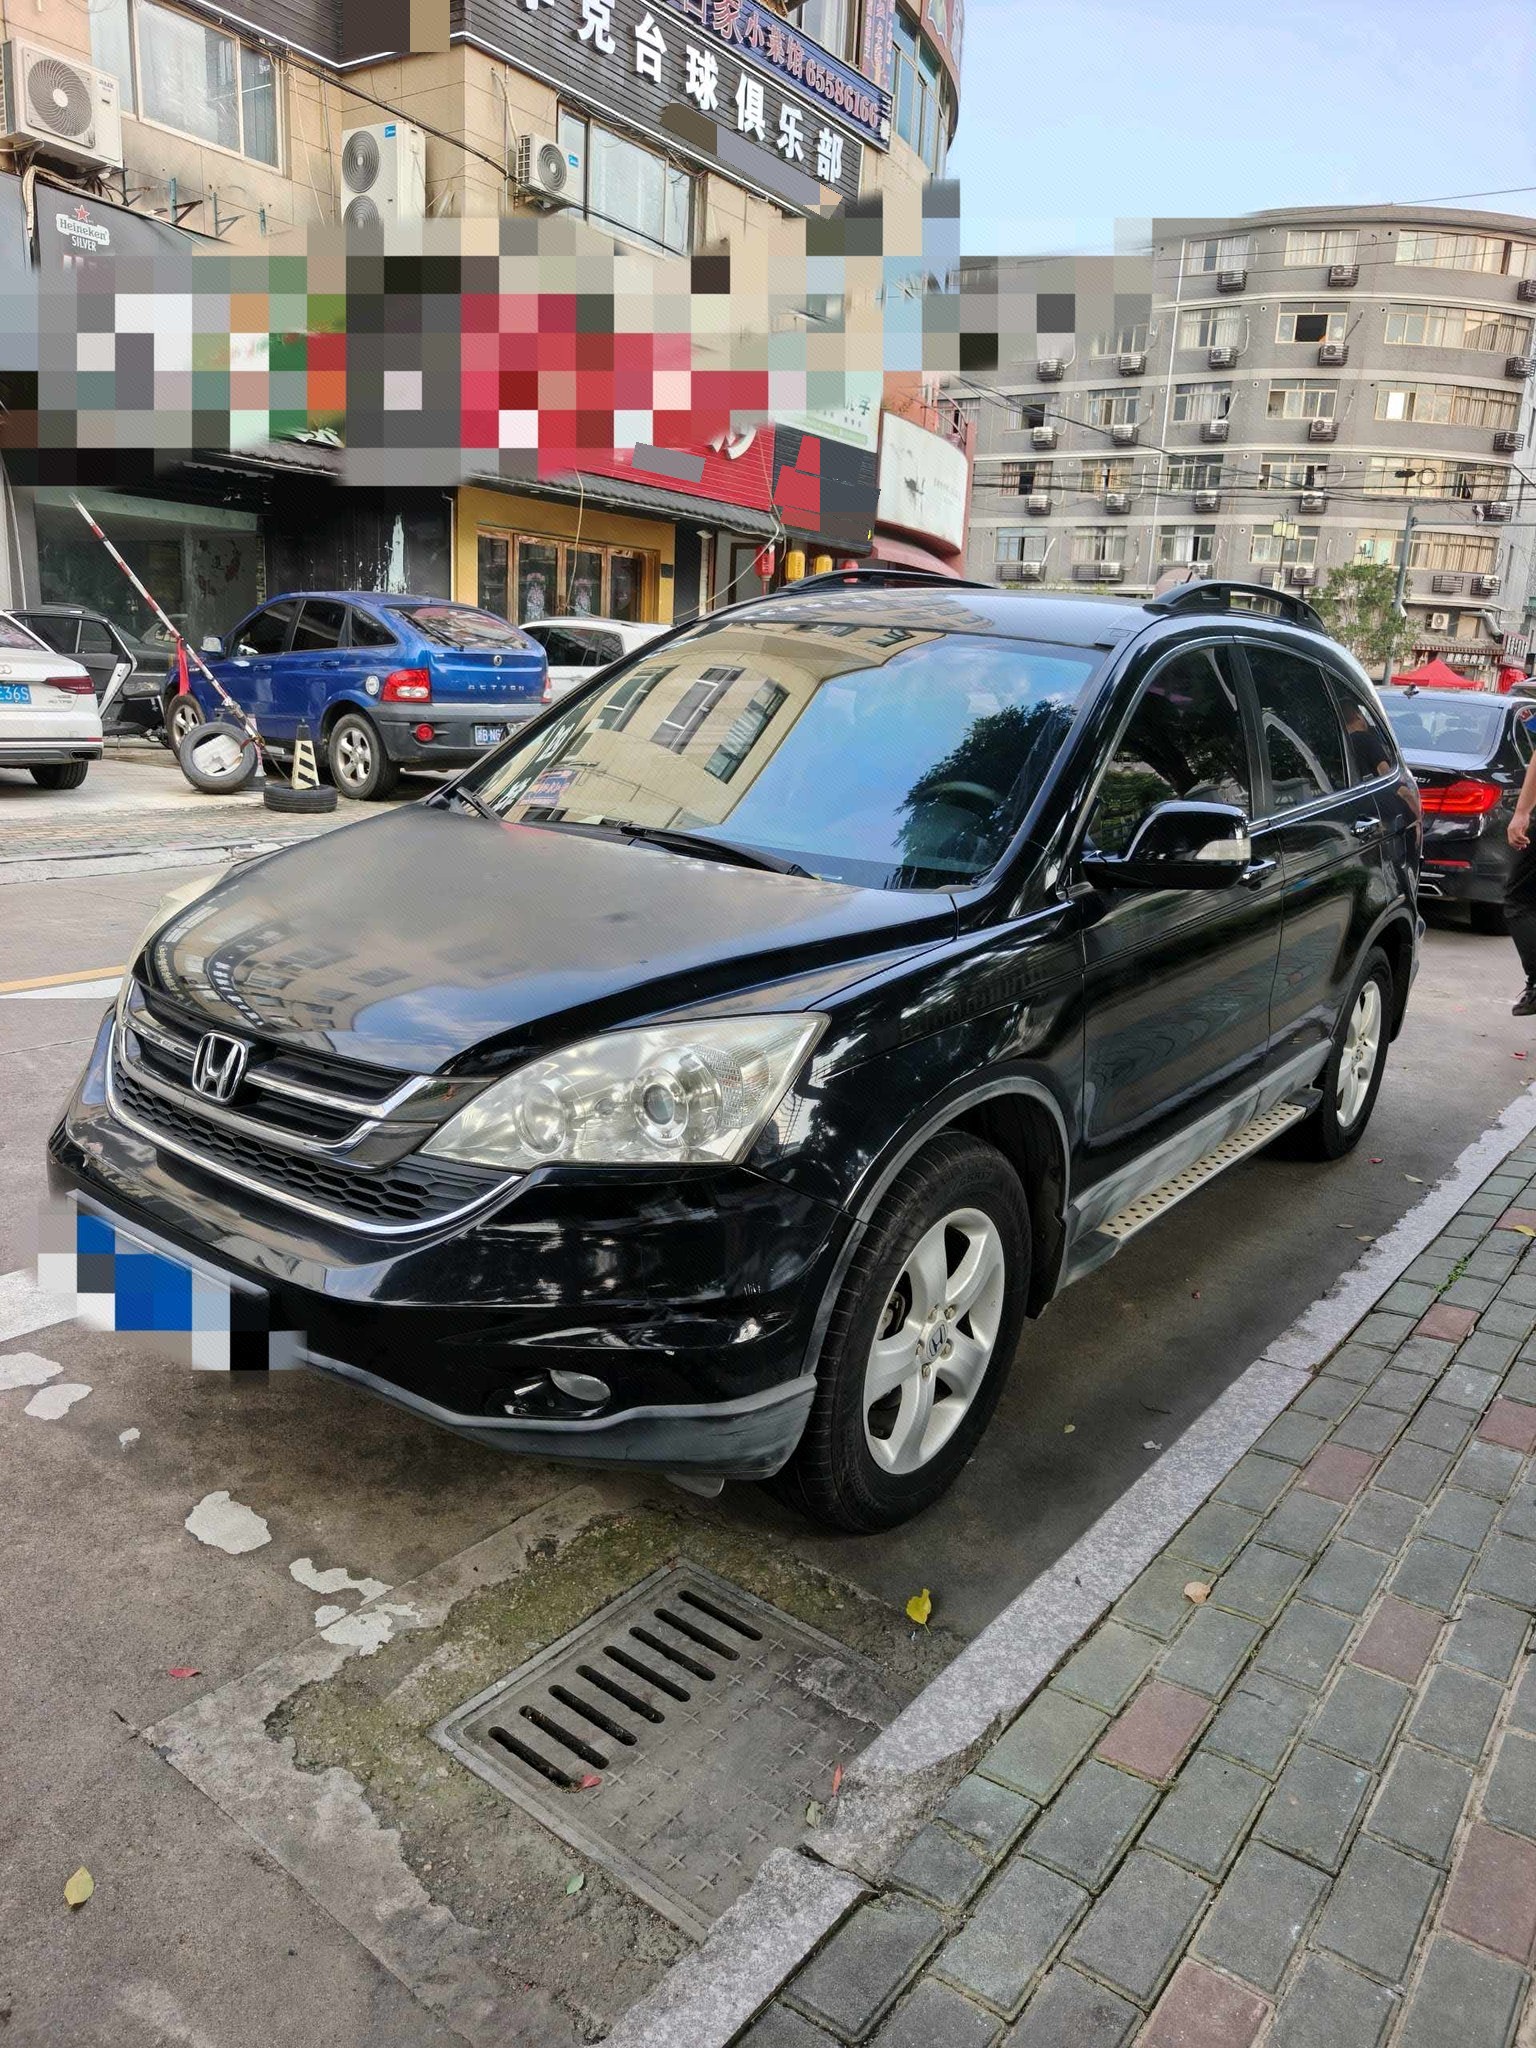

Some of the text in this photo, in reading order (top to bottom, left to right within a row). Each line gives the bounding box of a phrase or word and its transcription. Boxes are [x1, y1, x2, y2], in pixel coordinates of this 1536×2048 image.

[525, 0, 844, 184] 克台球俱乐部
[805, 58, 879, 129] 65586166
[59, 218, 107, 241] Heineken
[71, 235, 97, 252] SILVER
